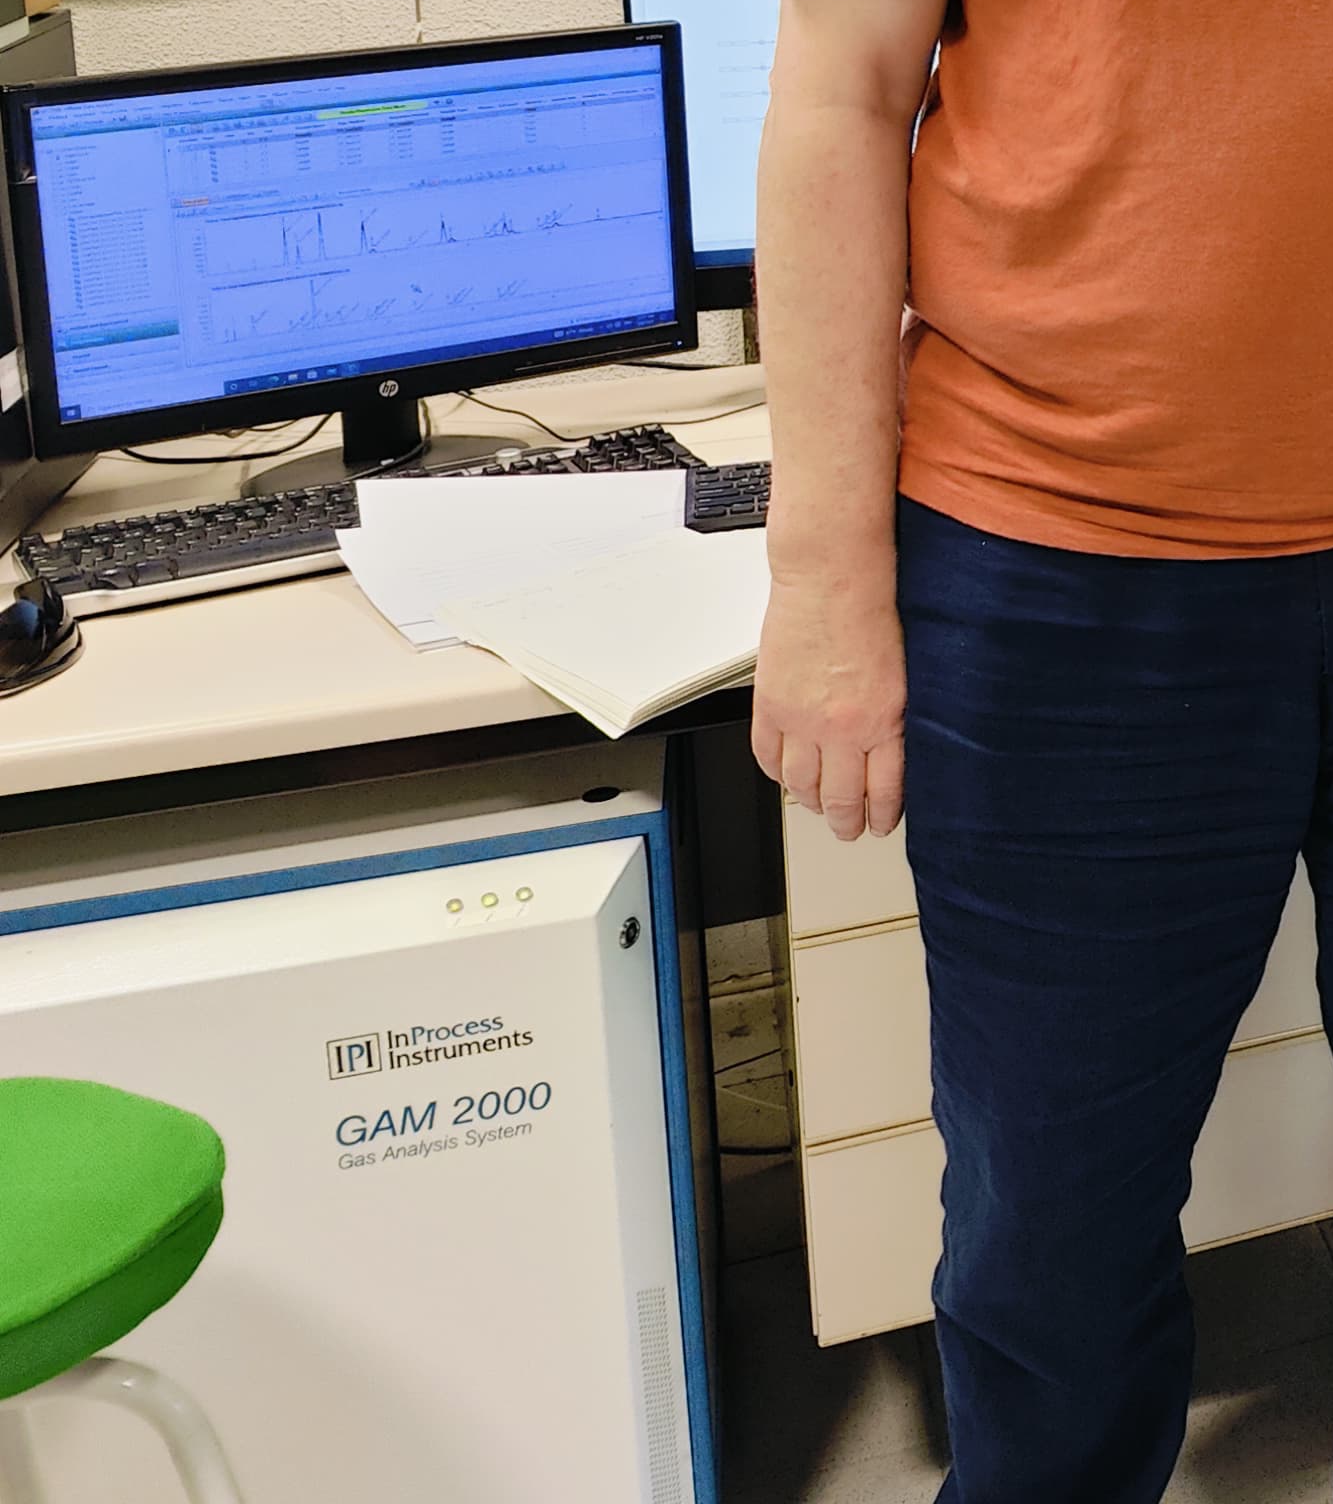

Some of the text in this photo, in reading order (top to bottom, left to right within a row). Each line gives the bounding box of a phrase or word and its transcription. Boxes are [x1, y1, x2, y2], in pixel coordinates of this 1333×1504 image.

[379, 380, 399, 398] hp
[334, 1016, 504, 1075] IPI InProcess
[389, 1030, 534, 1069] Instruments
[336, 1082, 552, 1146] GAM 2000
[338, 1122, 532, 1170] Gas Analysis System
